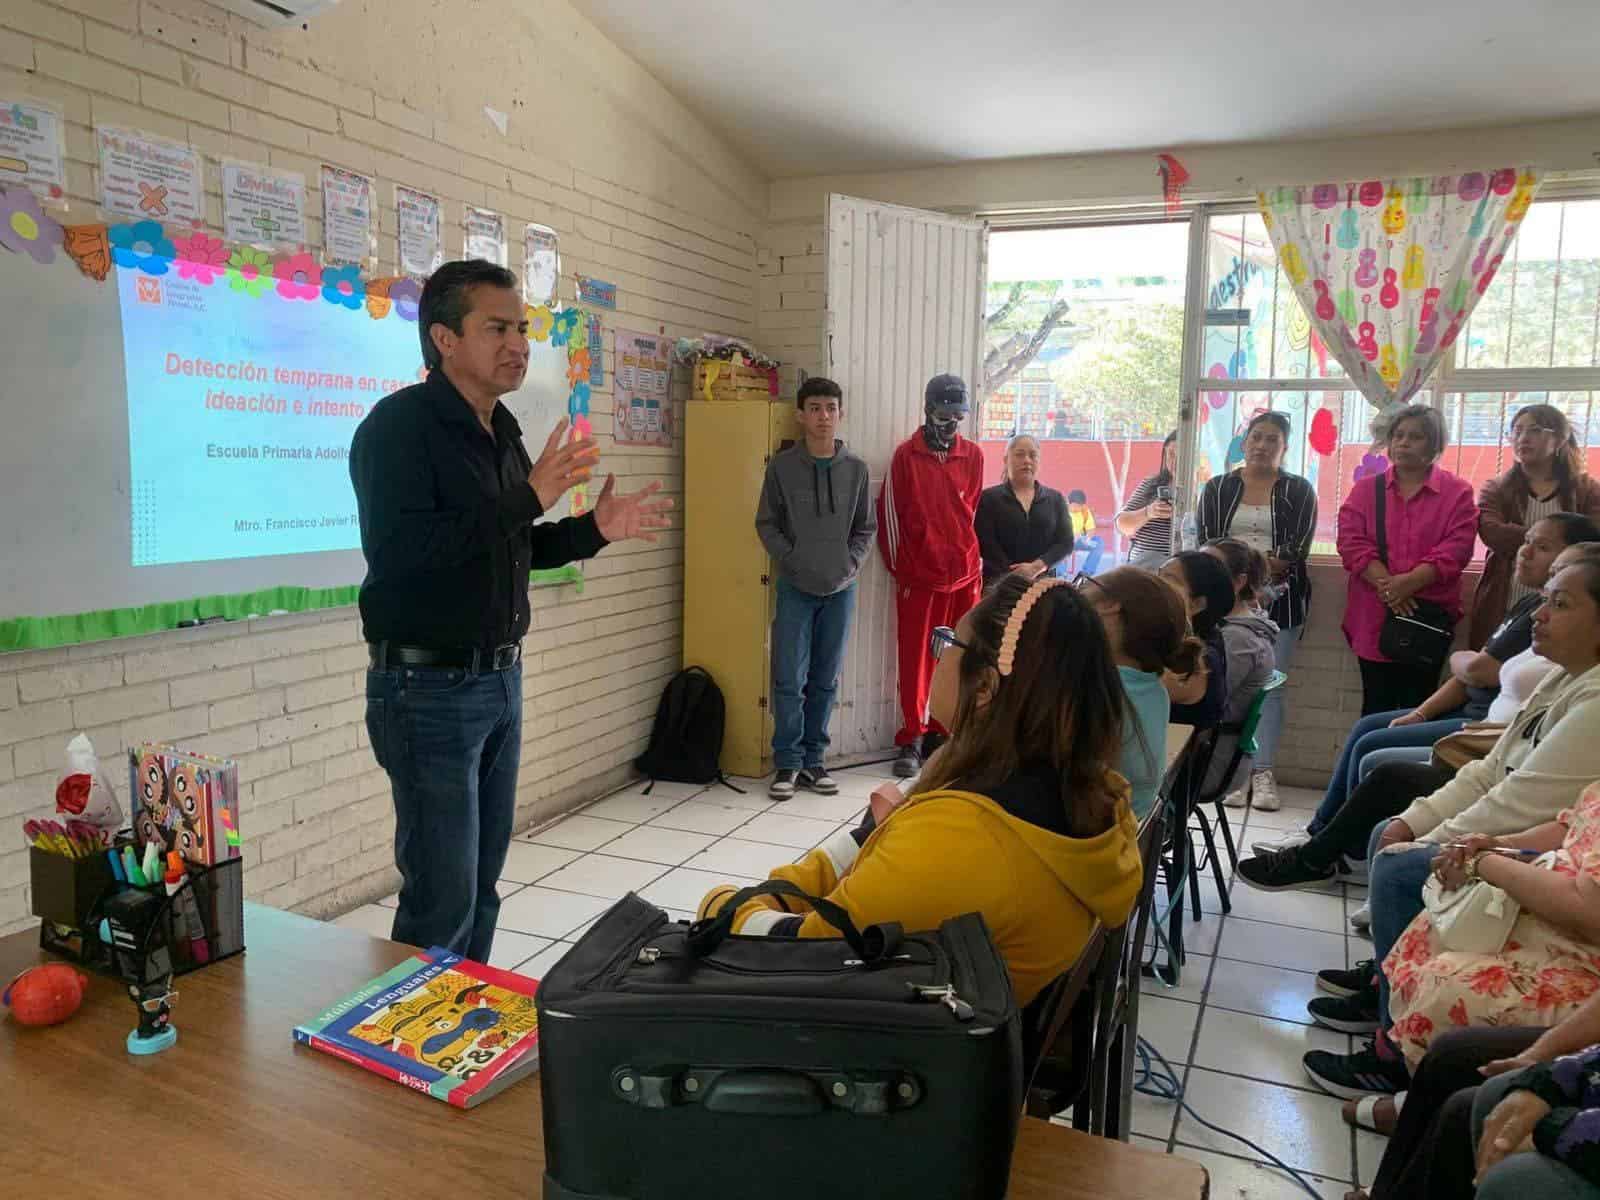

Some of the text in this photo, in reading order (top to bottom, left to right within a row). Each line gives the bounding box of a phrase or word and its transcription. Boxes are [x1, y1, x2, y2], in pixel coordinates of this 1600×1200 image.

[165, 352, 268, 383] Detección
[274, 366, 353, 391] temprana
[358, 376, 377, 392] en
[293, 400, 303, 415] e
[308, 396, 364, 418] intento
[206, 444, 259, 459] Escuela
[262, 445, 312, 460] Primaria
[265, 517, 317, 531] Francisco
[364, 965, 442, 1010] Lenguajes
